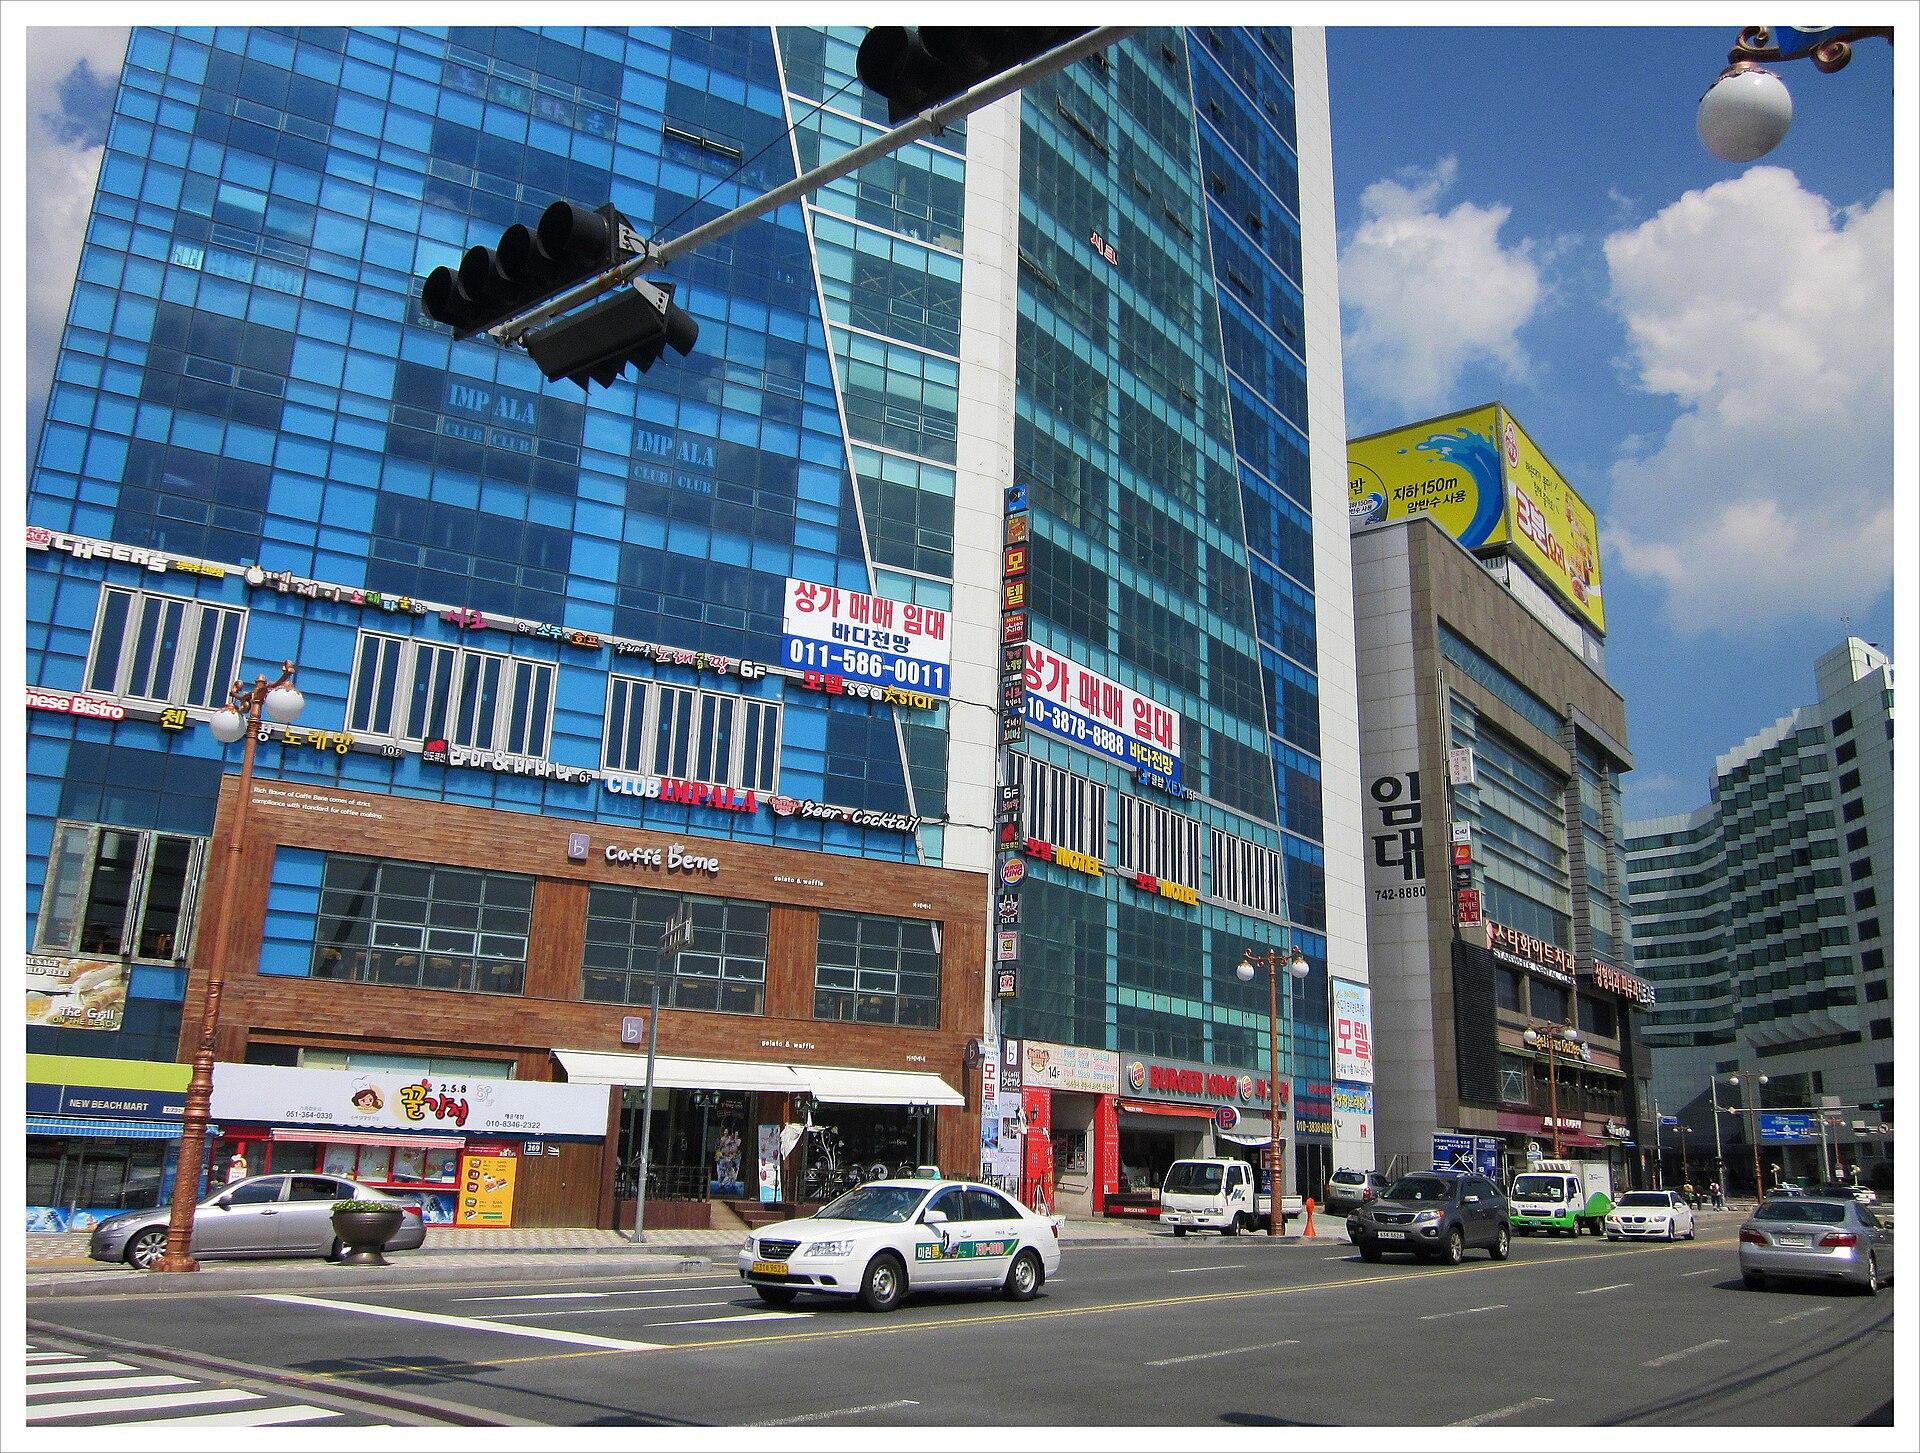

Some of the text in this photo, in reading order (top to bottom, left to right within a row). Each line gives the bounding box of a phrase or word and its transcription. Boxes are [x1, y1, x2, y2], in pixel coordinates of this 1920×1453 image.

[1393, 478, 1457, 501] 지하 150m
[1407, 491, 1466, 513] 암반수 사용
[54, 533, 169, 573] CHEERS
[1007, 552, 1023, 605] 모텔
[351, 589, 411, 611] 노래타운
[415, 603, 427, 614] 8F
[794, 582, 945, 640] 상가 매매 임대
[518, 623, 531, 633] 9F
[832, 622, 910, 653] 바다전망
[740, 660, 767, 679] 6F
[790, 638, 943, 689] 011-586-0011
[803, 670, 844, 695] 모텔
[71, 698, 124, 720] Bistro
[1024, 645, 1174, 750] 상가 매매 임대
[282, 728, 354, 754] 노래방
[382, 745, 402, 757] 10F
[1129, 739, 1174, 776] 바다전망
[579, 770, 592, 783] 6F
[1165, 778, 1184, 799] XEX
[608, 777, 659, 799] CLUB
[659, 779, 757, 813] IMPALA
[1004, 787, 1018, 798] 6F
[330, 806, 339, 814] for
[802, 802, 842, 820] Beer
[852, 810, 921, 833] Cocktail
[1371, 771, 1425, 880] 임대
[1004, 863, 1022, 873] BURGER
[1025, 837, 1104, 877] 모텔 MOTEL
[1004, 868, 1022, 879] KING
[1160, 879, 1200, 907] MOTEL
[1375, 886, 1426, 901] 742-8880
[1496, 924, 1576, 976] 스타화이트치과
[60, 1006, 114, 1020] The Grill
[1338, 1018, 1369, 1059] 모텔
[1048, 1066, 1060, 1079] 14F
[1149, 1066, 1204, 1095] BURGER
[1206, 1073, 1237, 1098] KING
[440, 1084, 467, 1093] 2.5.8
[69, 1099, 149, 1111] NEW BEACH MART
[286, 1111, 333, 1120] 051-364-0330
[486, 1119, 541, 1129] 010-8346-2322
